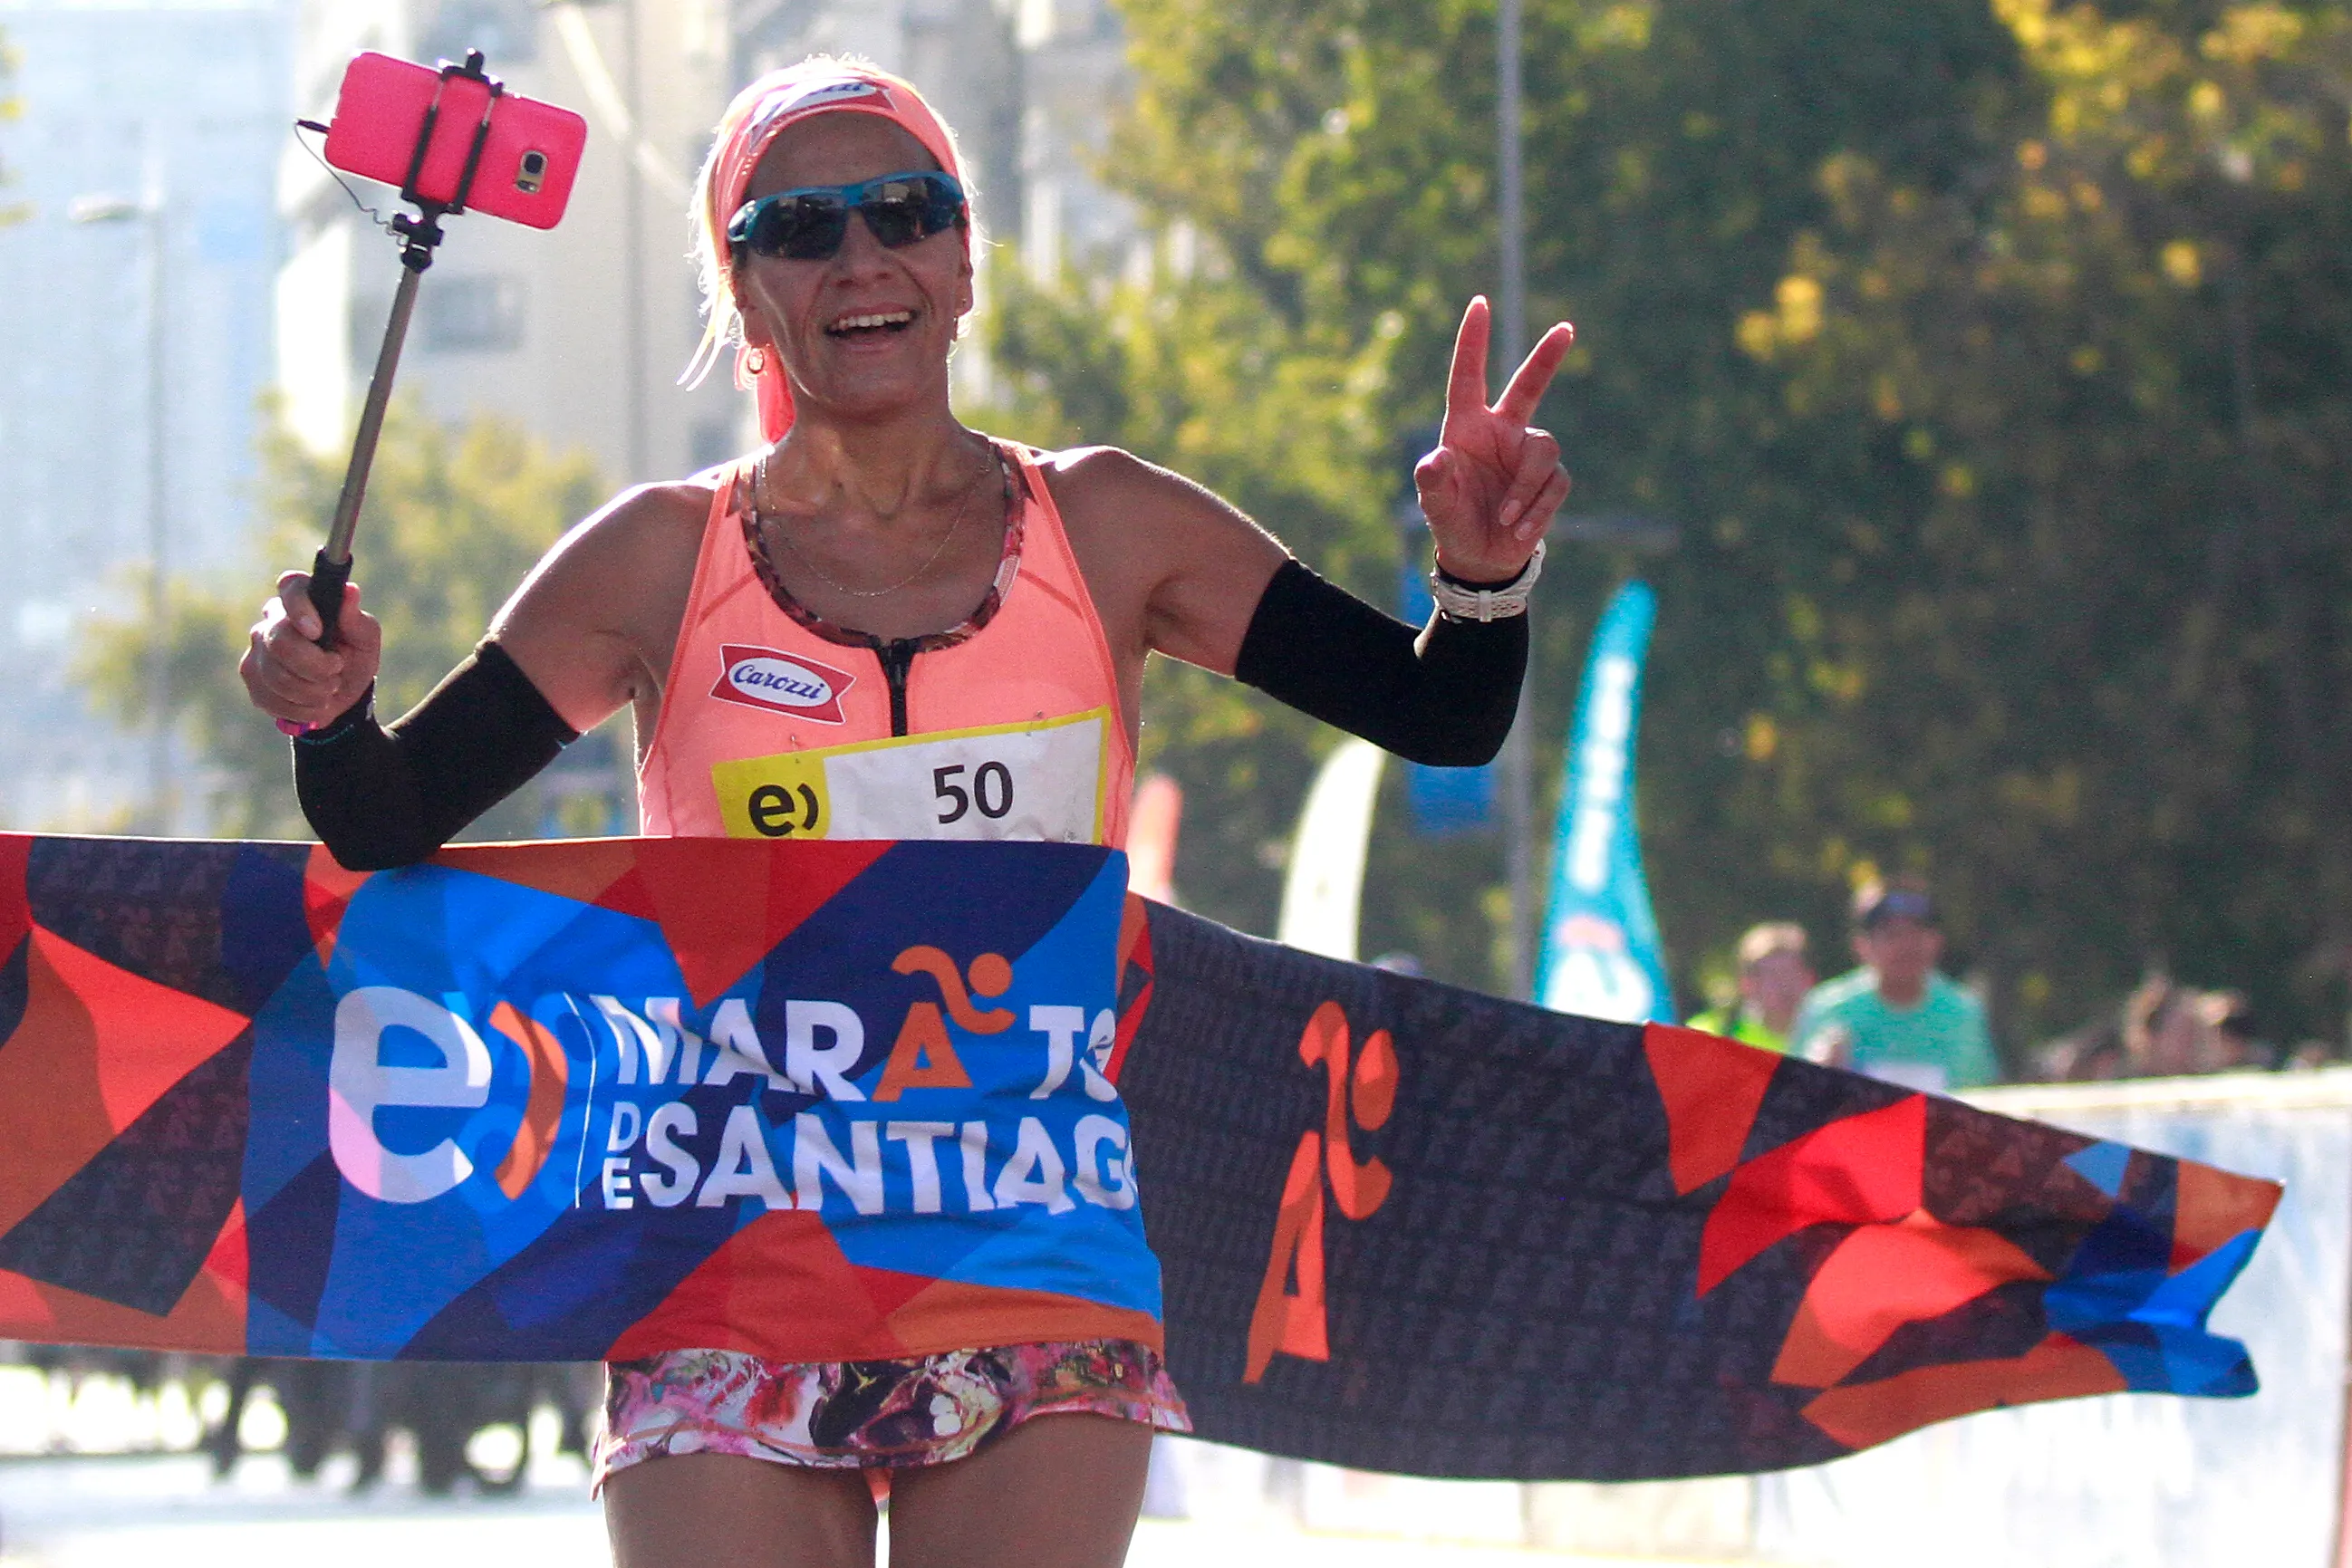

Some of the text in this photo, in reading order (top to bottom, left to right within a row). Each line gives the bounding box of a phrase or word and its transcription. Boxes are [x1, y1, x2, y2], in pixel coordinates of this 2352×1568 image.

[734, 664, 824, 699] Carozzi
[932, 761, 1014, 824] 50
[640, 1101, 1138, 1215] SANTIAG
